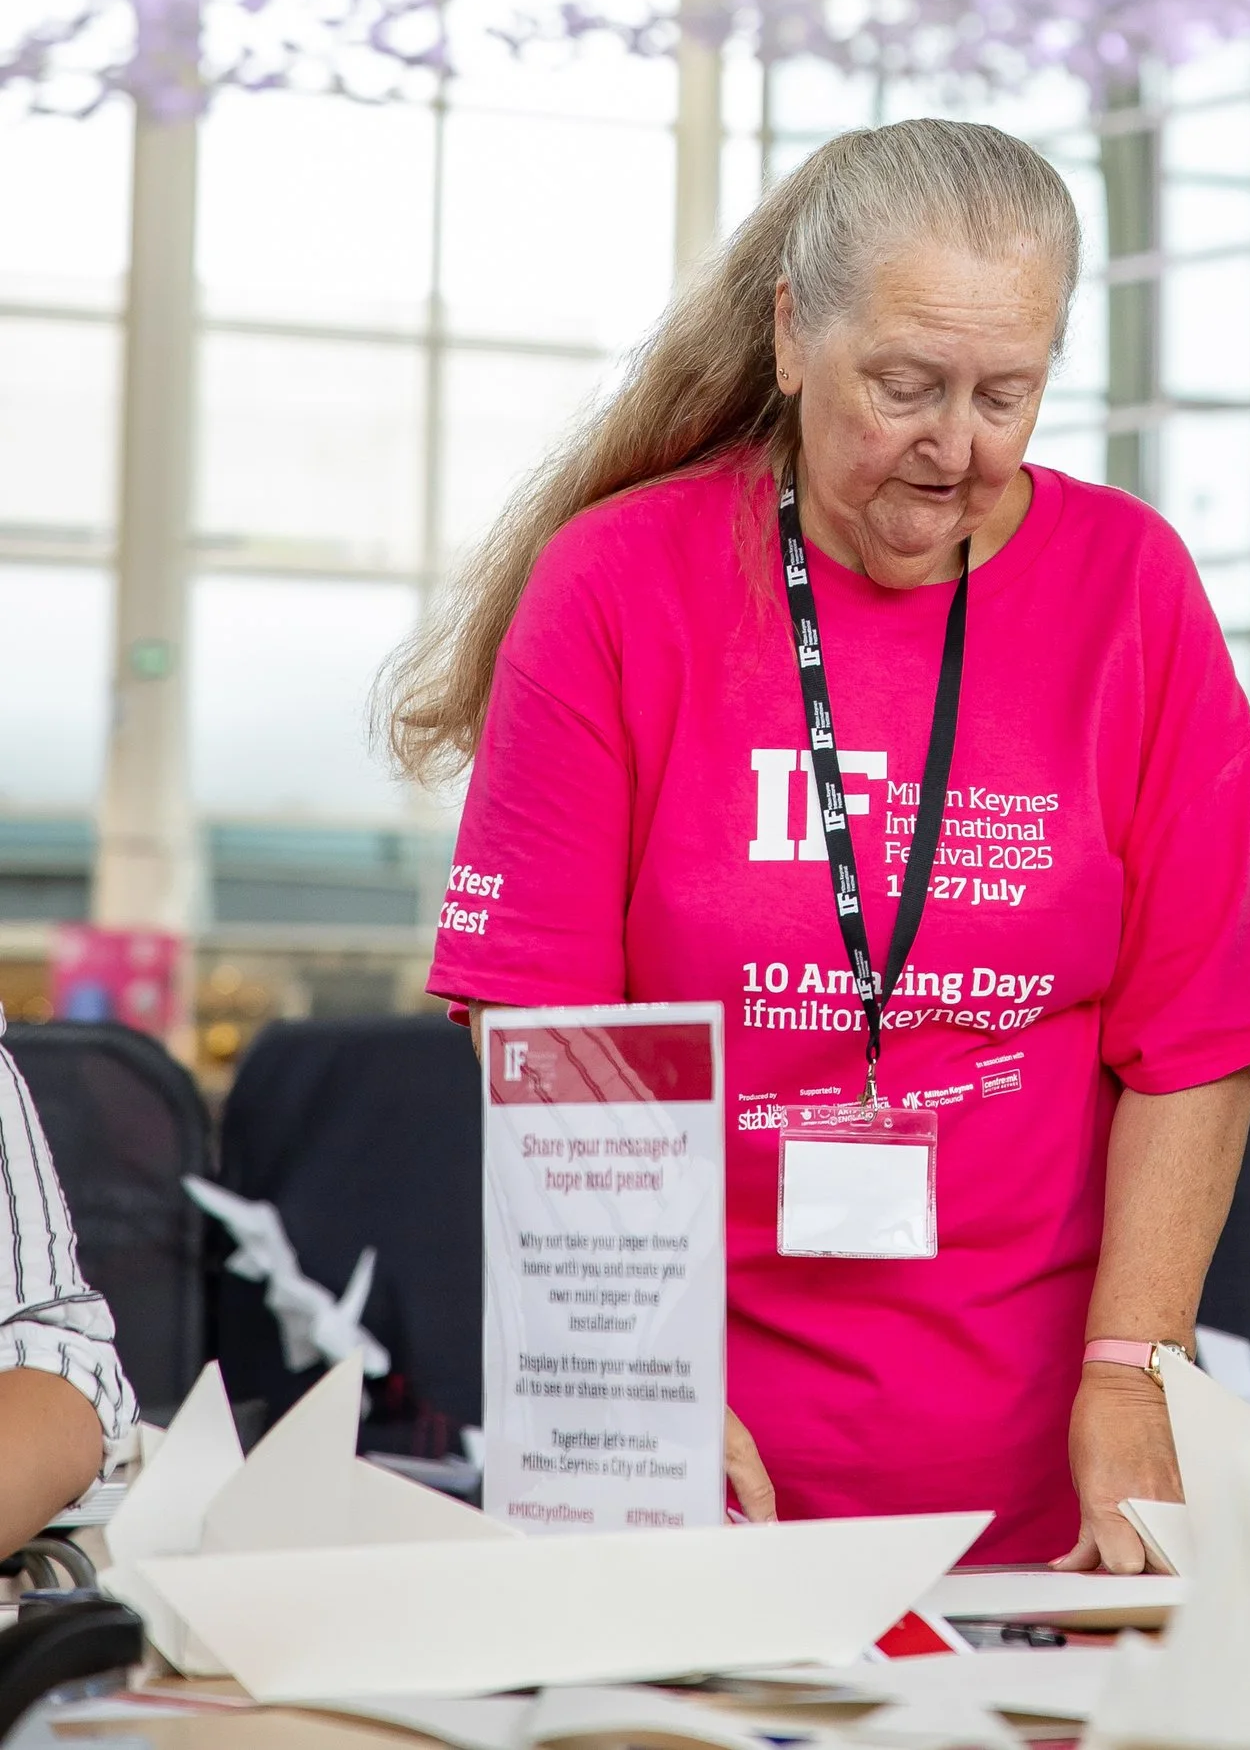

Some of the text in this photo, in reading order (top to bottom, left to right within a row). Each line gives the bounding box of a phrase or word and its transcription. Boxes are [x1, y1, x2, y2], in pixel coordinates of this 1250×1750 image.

[786, 565, 808, 587] IF
[799, 646, 820, 668] IF
[811, 728, 833, 750] IF
[749, 748, 888, 861] IF
[886, 781, 1059, 817] Miln Keynes
[823, 810, 846, 833] IF
[885, 811, 1045, 841] Intnational
[885, 842, 1053, 870] Feival 2025
[887, 875, 1027, 907] 1-27 July
[837, 892, 859, 917] IF
[742, 962, 789, 993] 10
[970, 967, 1055, 1004] Days
[856, 978, 873, 1001] IF
[504, 1041, 528, 1082] IF
[738, 1092, 777, 1101] Produced by
[800, 1087, 841, 1096] Supported by
[924, 1083, 974, 1099] Milton Keynes
[925, 1094, 964, 1108] City Council
[738, 1104, 789, 1130] stables
[522, 1131, 688, 1162] Share your message of
[545, 1167, 582, 1195] hope
[585, 1167, 613, 1191] and
[520, 1231, 542, 1252] Why
[566, 1232, 587, 1249] take
[592, 1234, 615, 1252] your
[618, 1234, 648, 1252] paper
[522, 1260, 552, 1276] home
[555, 1260, 579, 1277] with
[582, 1264, 601, 1281] you
[519, 1353, 558, 1376] Display
[628, 1356, 673, 1376] window
[578, 1380, 608, 1398] share
[552, 1428, 600, 1450] Together
[522, 1453, 557, 1472] Milton
